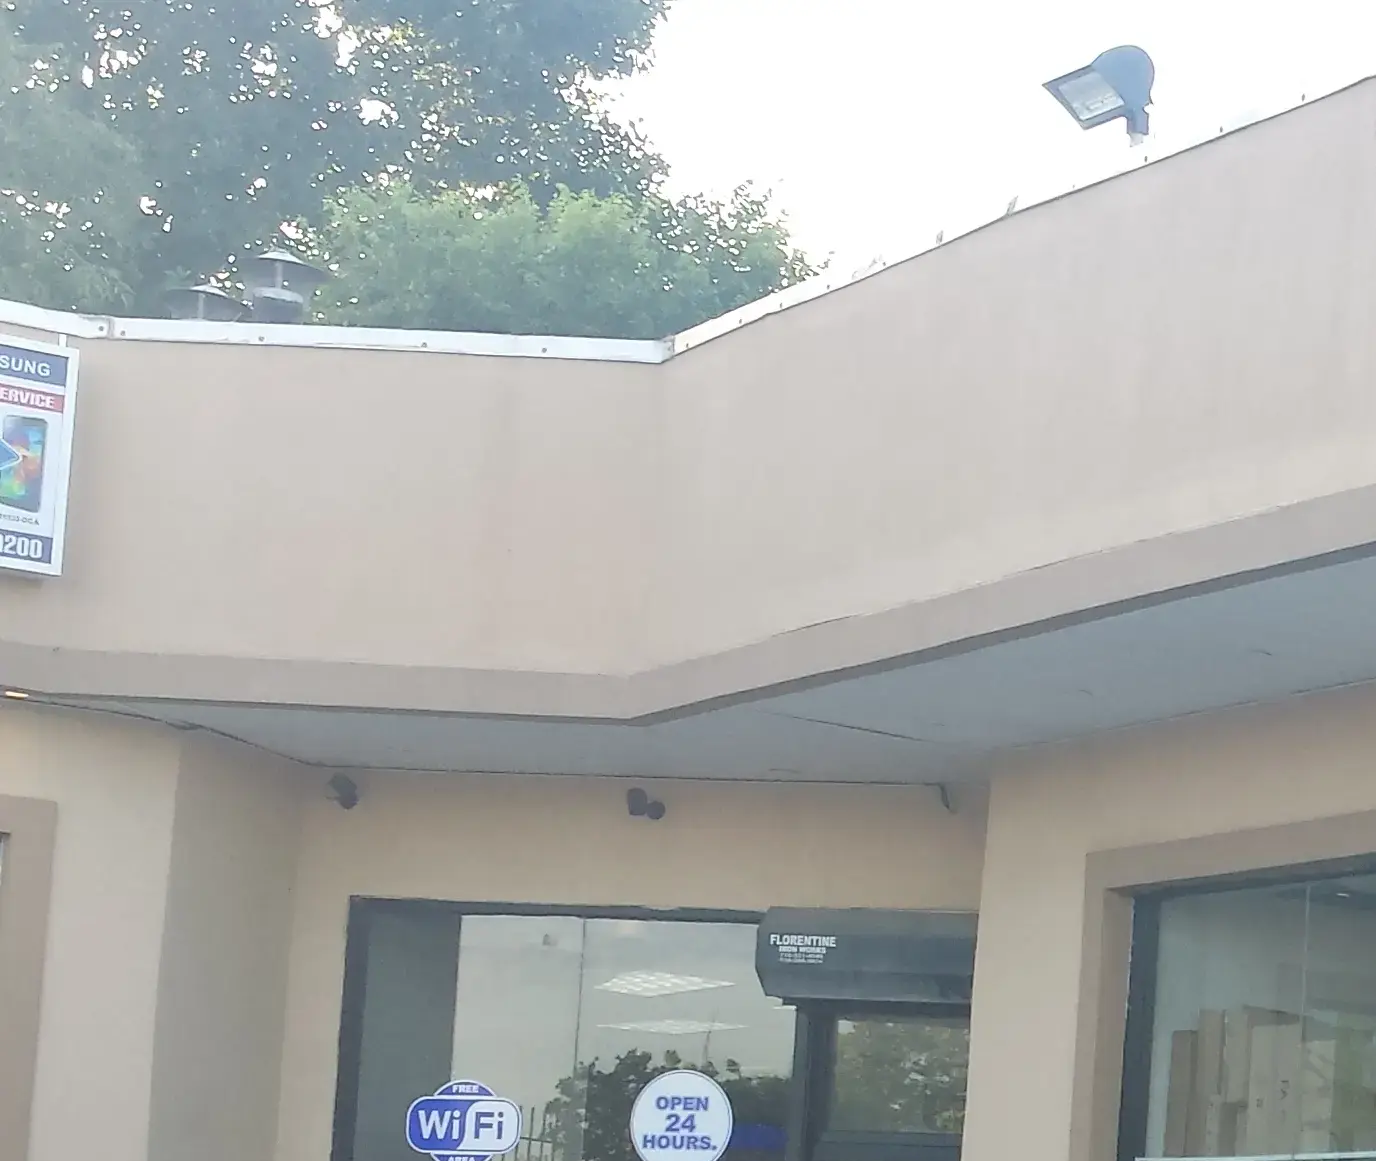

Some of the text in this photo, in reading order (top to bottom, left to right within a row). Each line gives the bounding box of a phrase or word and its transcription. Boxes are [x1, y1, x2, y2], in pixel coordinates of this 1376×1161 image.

[0, 355, 51, 377] SUNG
[0, 387, 55, 408] ERVICE
[0, 533, 43, 559] 200
[769, 933, 837, 948] FLORENTINE
[452, 1084, 480, 1094] FREE
[655, 1096, 710, 1111] OPEN
[665, 1113, 697, 1133] 24
[642, 1135, 719, 1151] HOURS.
